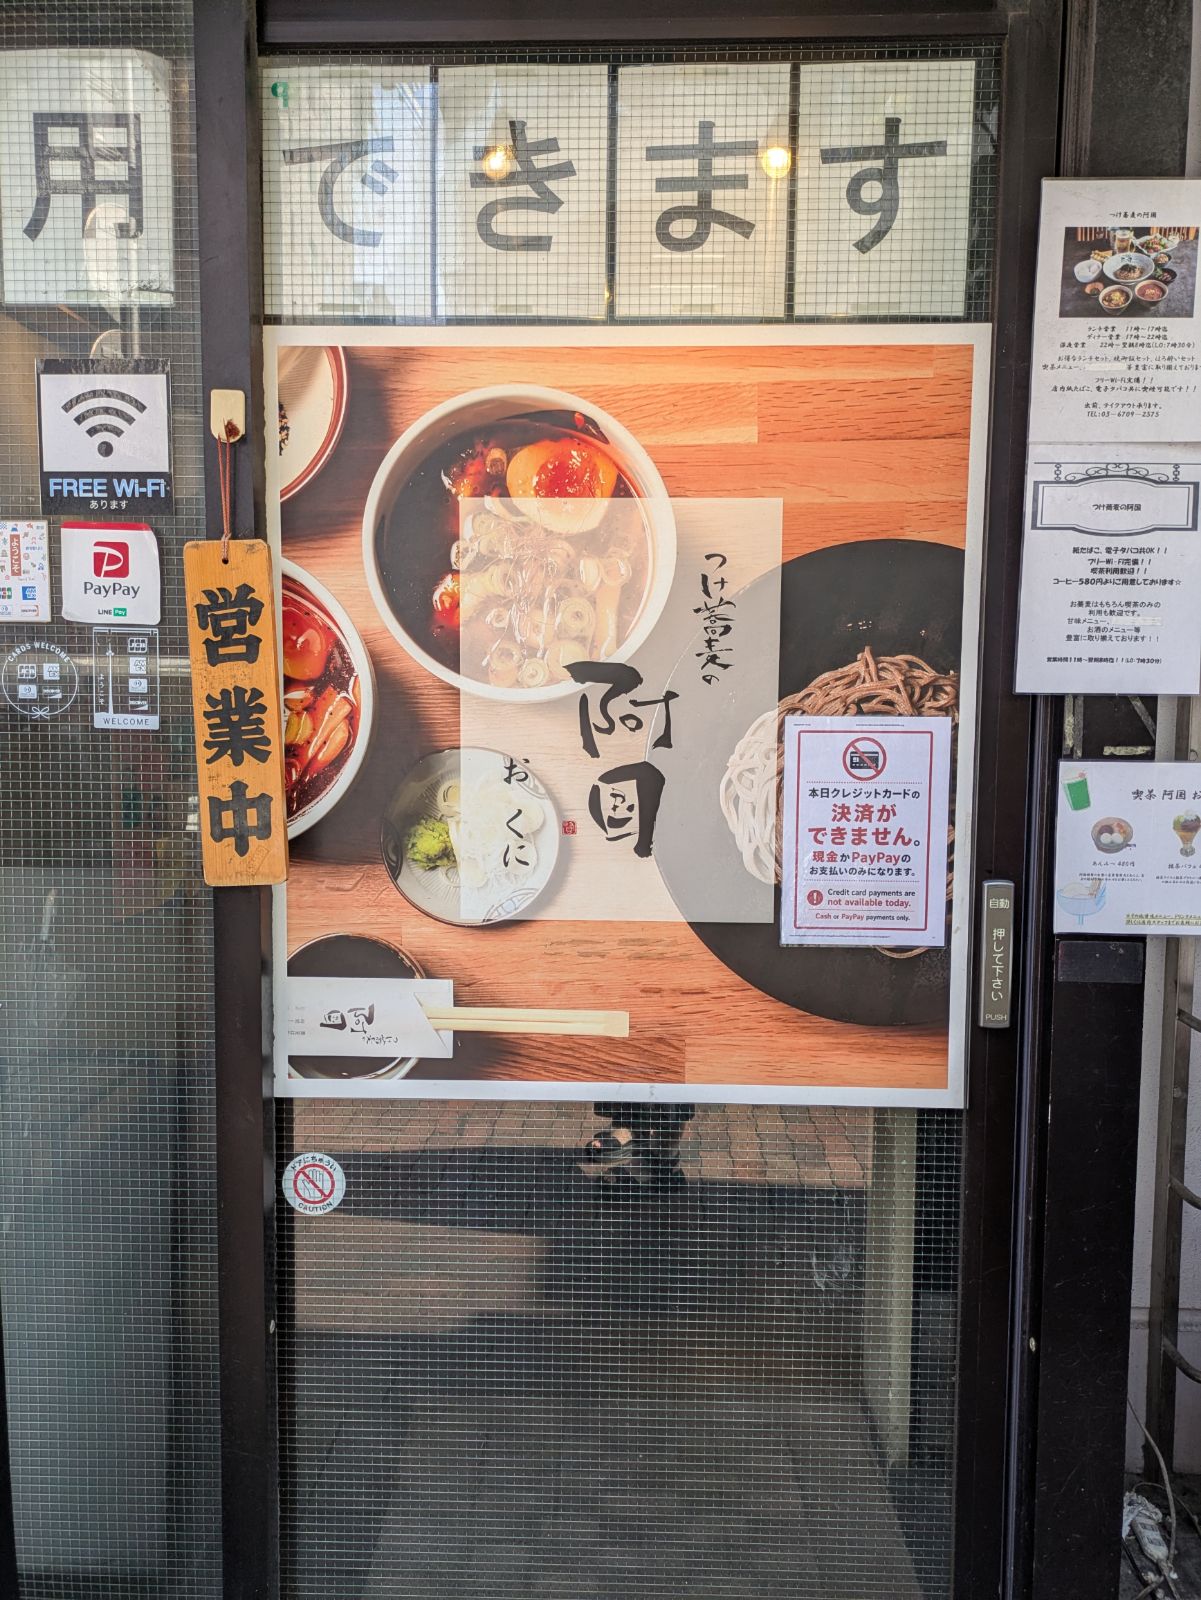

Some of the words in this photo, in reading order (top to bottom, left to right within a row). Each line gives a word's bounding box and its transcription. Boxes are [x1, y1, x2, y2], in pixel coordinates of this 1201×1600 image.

[23, 111, 144, 242] 用
[281, 115, 948, 254] できます
[49, 478, 108, 498] FREE
[113, 478, 165, 498] Wi-Fi
[89, 500, 129, 510] あります
[1092, 503, 1141, 511] つけ蕎麦の阿国
[11, 537, 20, 573] ようこそ
[83, 581, 140, 599] PayPay
[1070, 600, 1161, 609] お蕎麦はもちろん喫茶のみの
[114, 608, 126, 616] Pay
[1088, 609, 1141, 617] 利用も歓迎です。
[693, 553, 736, 685] つけ蕎麦の
[1087, 626, 1141, 634] お酒のメニュー等
[7, 643, 31, 662] CARDS
[34, 641, 71, 663] WELCOME
[103, 717, 150, 726] WELCOME
[195, 583, 272, 857] 営業中
[562, 661, 680, 858] 阿国
[808, 787, 920, 799] 本日クレジットカードの
[1131, 788, 1157, 801] 喫茶
[1161, 789, 1186, 801] 阿国
[502, 758, 531, 868] おくに
[831, 803, 897, 823] 決済が
[807, 826, 920, 847] できません。
[812, 850, 911, 865] 現金かPayPayの
[809, 866, 916, 876] お支払いのみになります。
[827, 888, 850, 896] Credit
[868, 889, 902, 898] payments
[827, 898, 842, 906] not
[843, 898, 883, 907] available
[885, 899, 911, 908] today.
[989, 898, 1010, 909] 自動
[841, 913, 864, 921] PayPay
[896, 914, 911, 922] only.
[991, 928, 1005, 1001] 押して下さい
[298, 1201, 333, 1212] CAUTION
